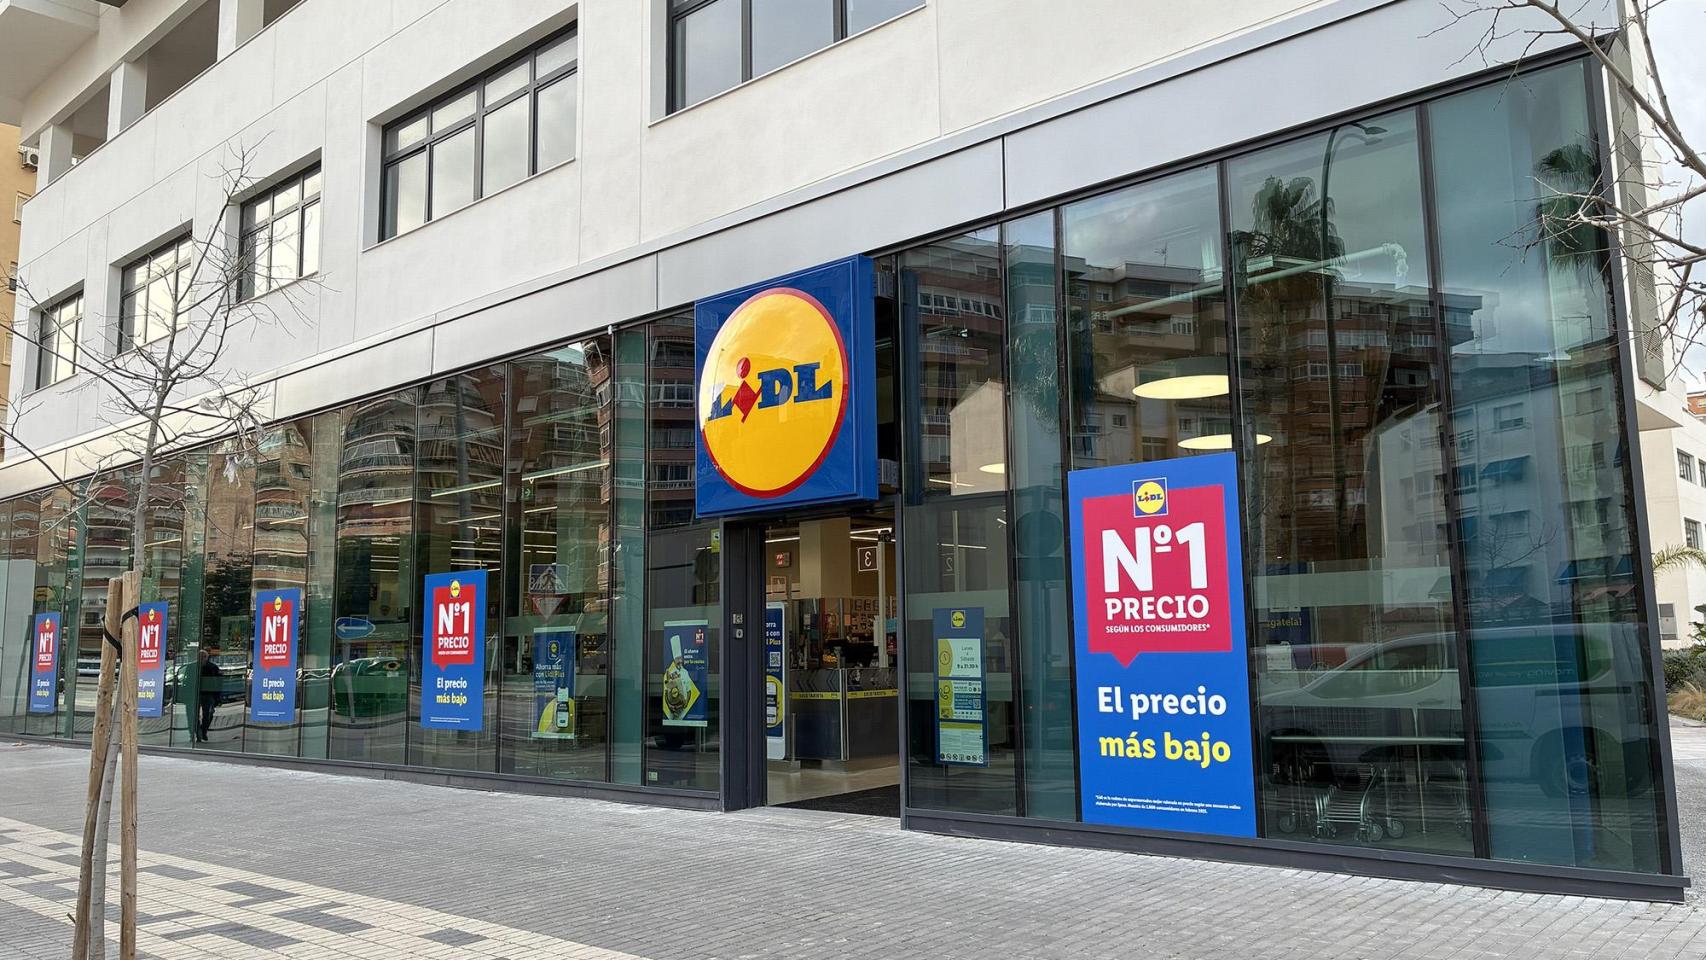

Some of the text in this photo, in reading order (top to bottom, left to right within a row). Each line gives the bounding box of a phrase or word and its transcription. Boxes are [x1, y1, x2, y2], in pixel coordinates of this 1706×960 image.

[1105, 594, 1209, 620] PRECIO
[1105, 624, 1129, 633] SEGÚN
[1130, 625, 1144, 633] LOS
[264, 643, 287, 654] PRECIO
[438, 636, 468, 649] PRECIO
[140, 649, 158, 658] PRECIO
[268, 678, 285, 689] precio
[436, 677, 467, 691] El precio
[436, 692, 467, 707] más bajo
[1098, 685, 1227, 720] El precio
[1099, 731, 1231, 769] más bajo
